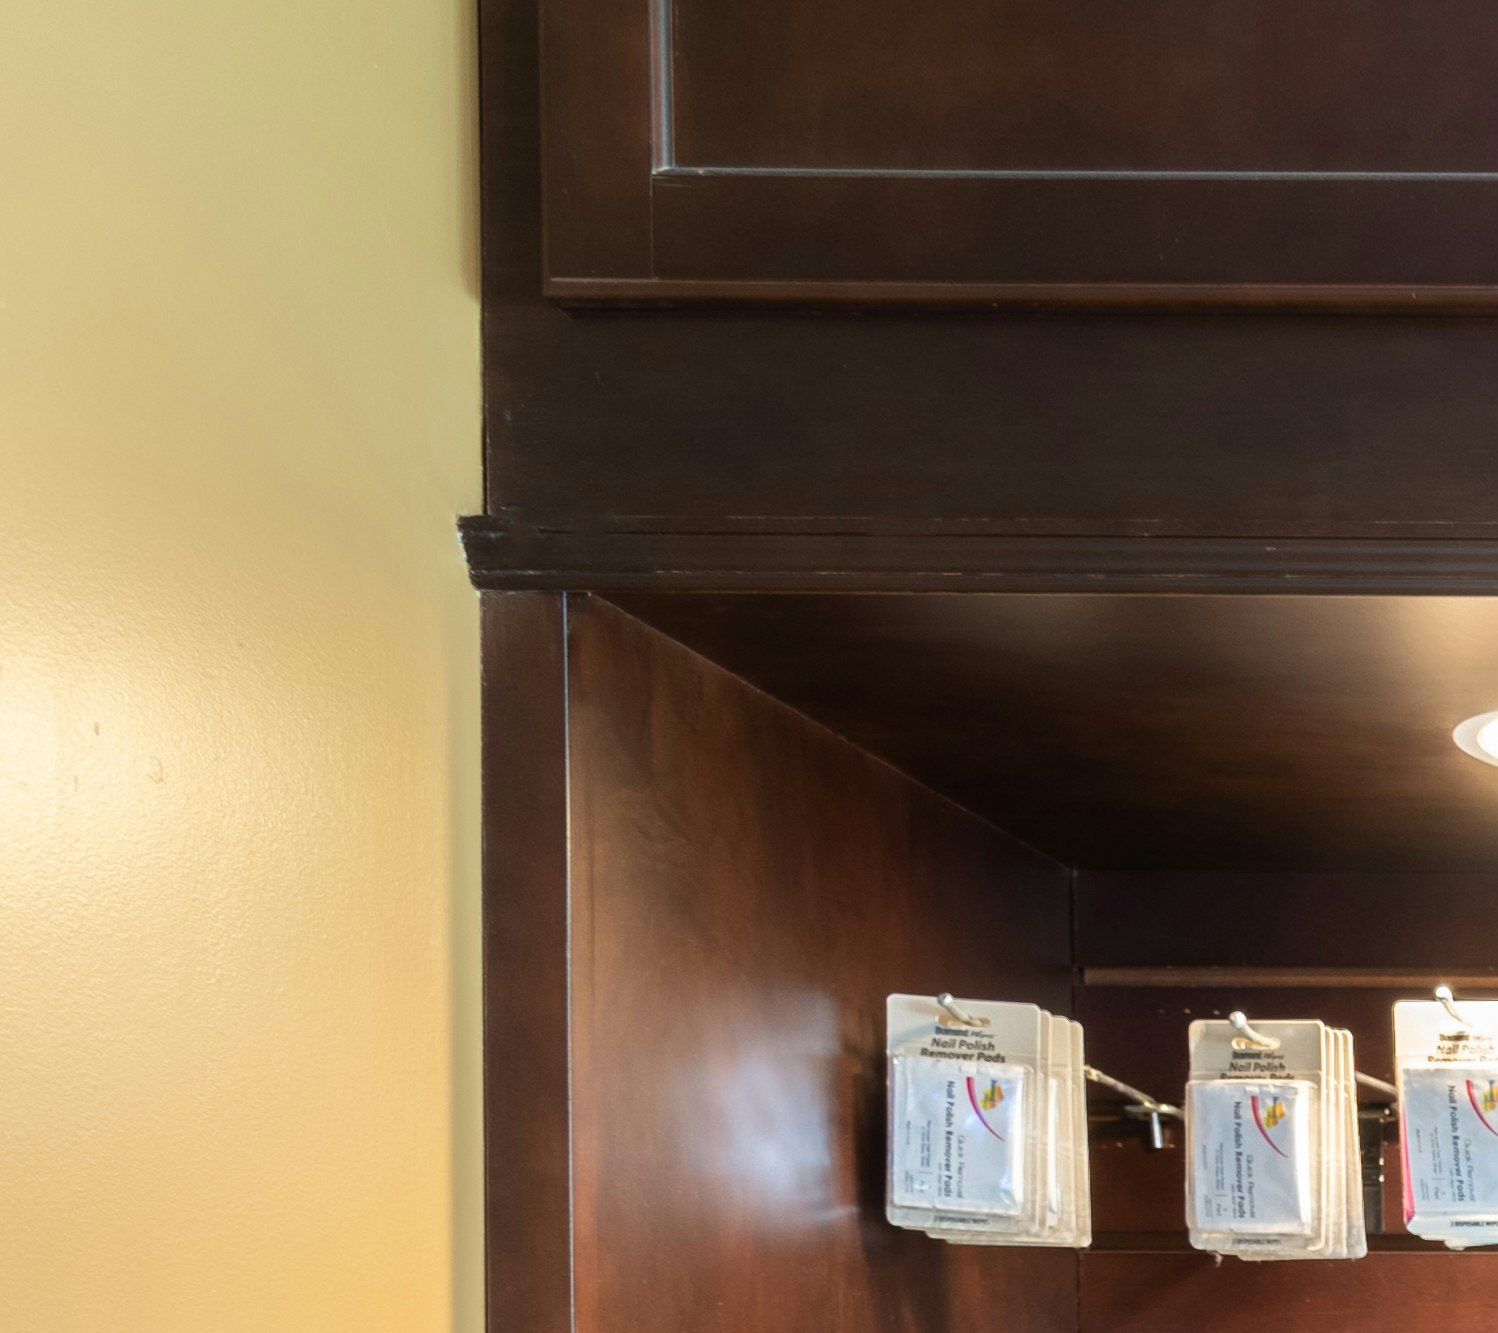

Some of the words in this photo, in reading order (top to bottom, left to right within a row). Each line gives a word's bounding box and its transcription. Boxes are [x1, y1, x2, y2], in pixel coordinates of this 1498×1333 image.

[931, 1037, 956, 1048] Nail
[958, 1039, 995, 1051] Polish
[920, 1048, 974, 1061] Remover
[977, 1051, 1006, 1063] Pads
[945, 1131, 953, 1176] Remover
